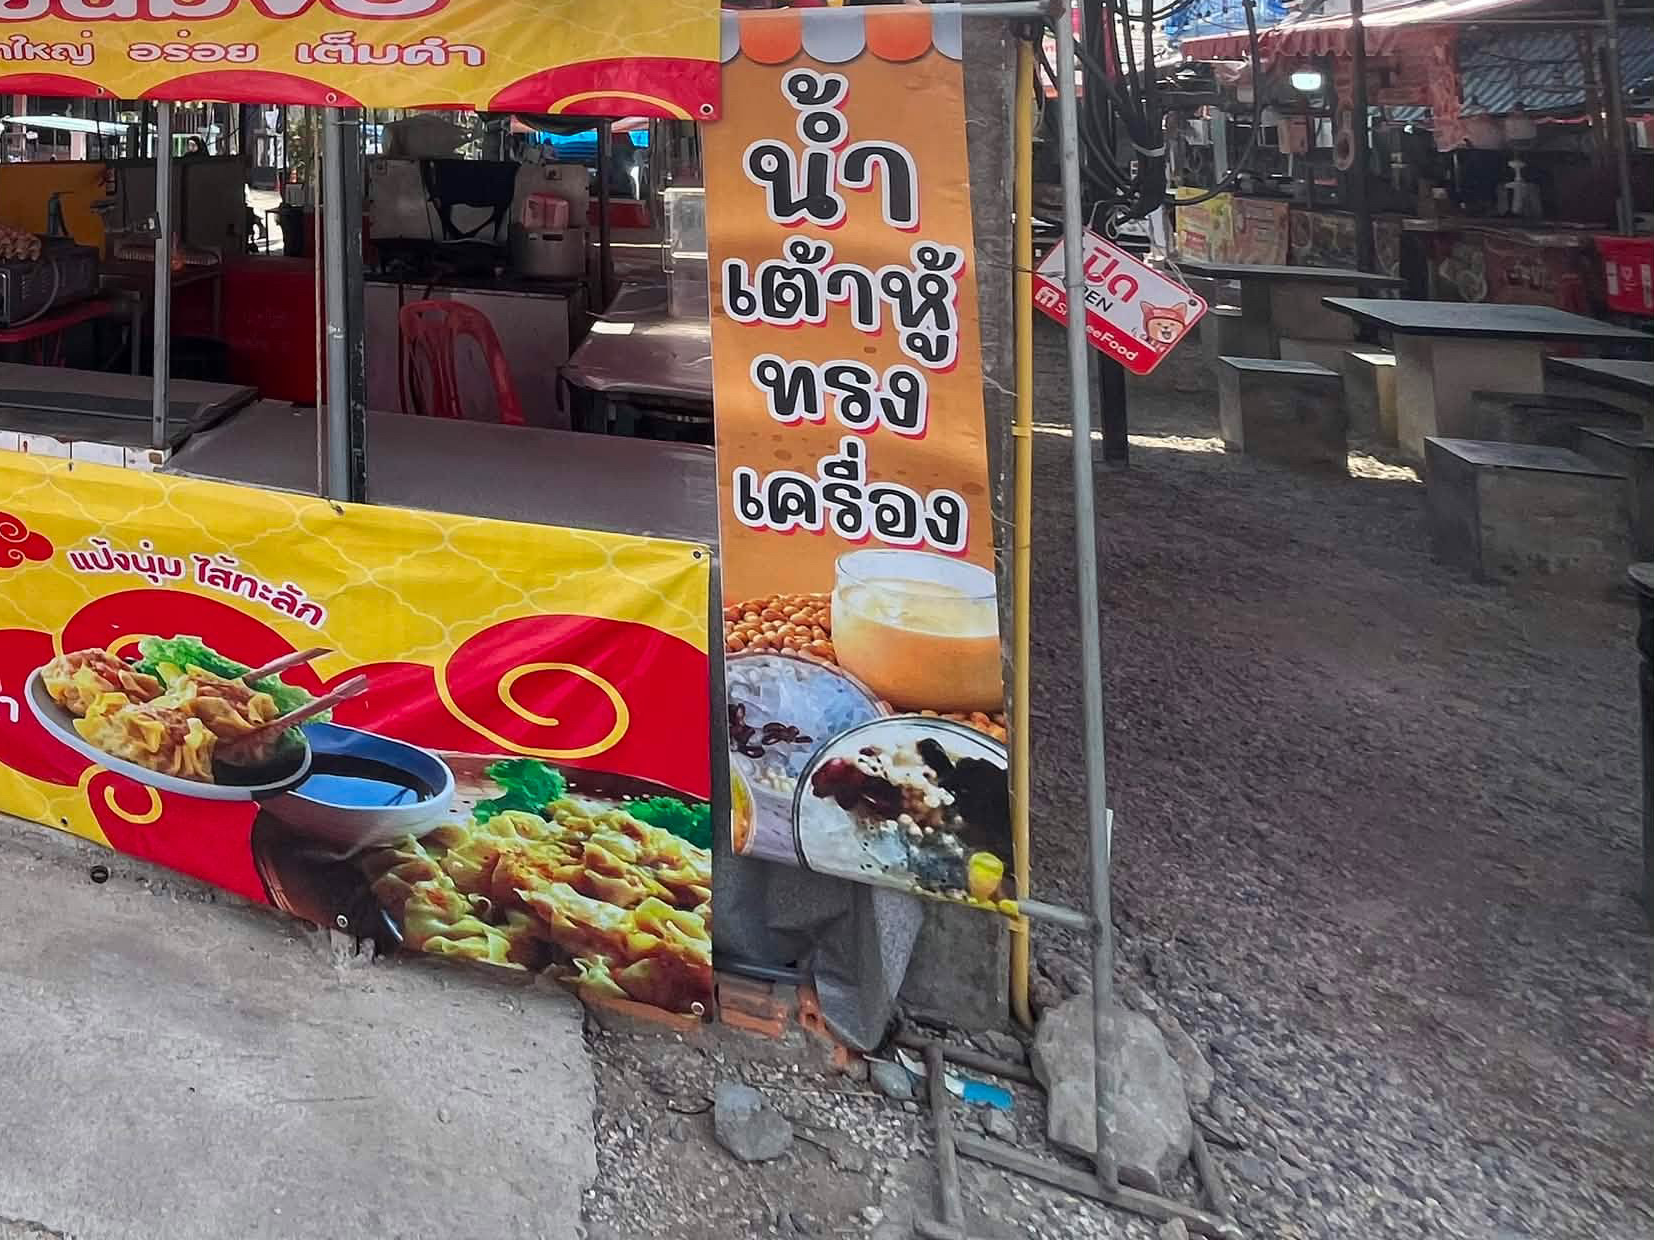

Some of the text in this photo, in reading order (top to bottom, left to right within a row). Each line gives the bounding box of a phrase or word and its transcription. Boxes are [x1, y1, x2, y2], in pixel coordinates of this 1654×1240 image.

[128, 30, 257, 67] อร่อย
[297, 36, 486, 68] เต็มคำ
[746, 71, 916, 224] น้ำ
[726, 240, 958, 364] เต้าหู้
[1083, 246, 1139, 303] ปิด
[1083, 286, 1114, 312] EN
[756, 359, 922, 429] ทรง
[736, 441, 964, 548] เครื่อง
[66, 534, 327, 628] แป้งนุ่ม ไส้ทะลัก
